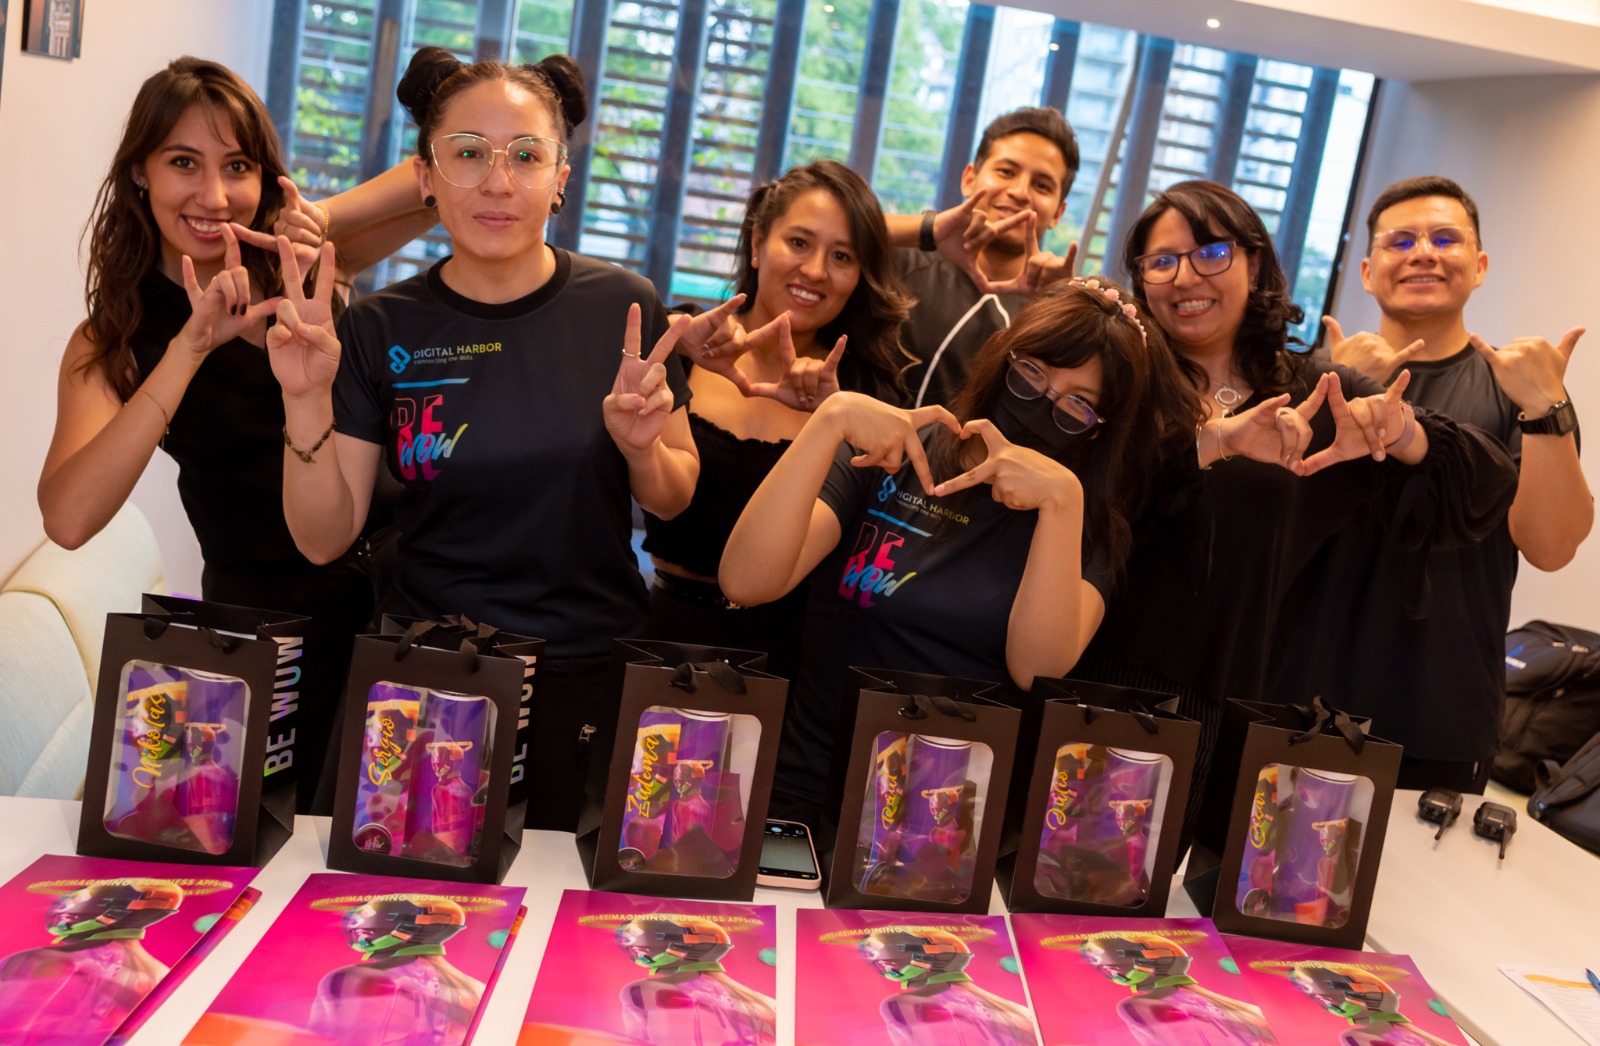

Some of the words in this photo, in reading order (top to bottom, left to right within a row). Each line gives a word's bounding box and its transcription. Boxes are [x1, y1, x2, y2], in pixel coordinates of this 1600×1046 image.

[413, 346, 454, 359] DIGITAL
[456, 342, 502, 354] HARBOR
[413, 357, 447, 365] connecting
[131, 692, 167, 789] Nikolas
[263, 727, 296, 777] BE
[367, 717, 402, 787] Sergio
[626, 733, 661, 818] Zulema
[1045, 770, 1069, 831] Julio
